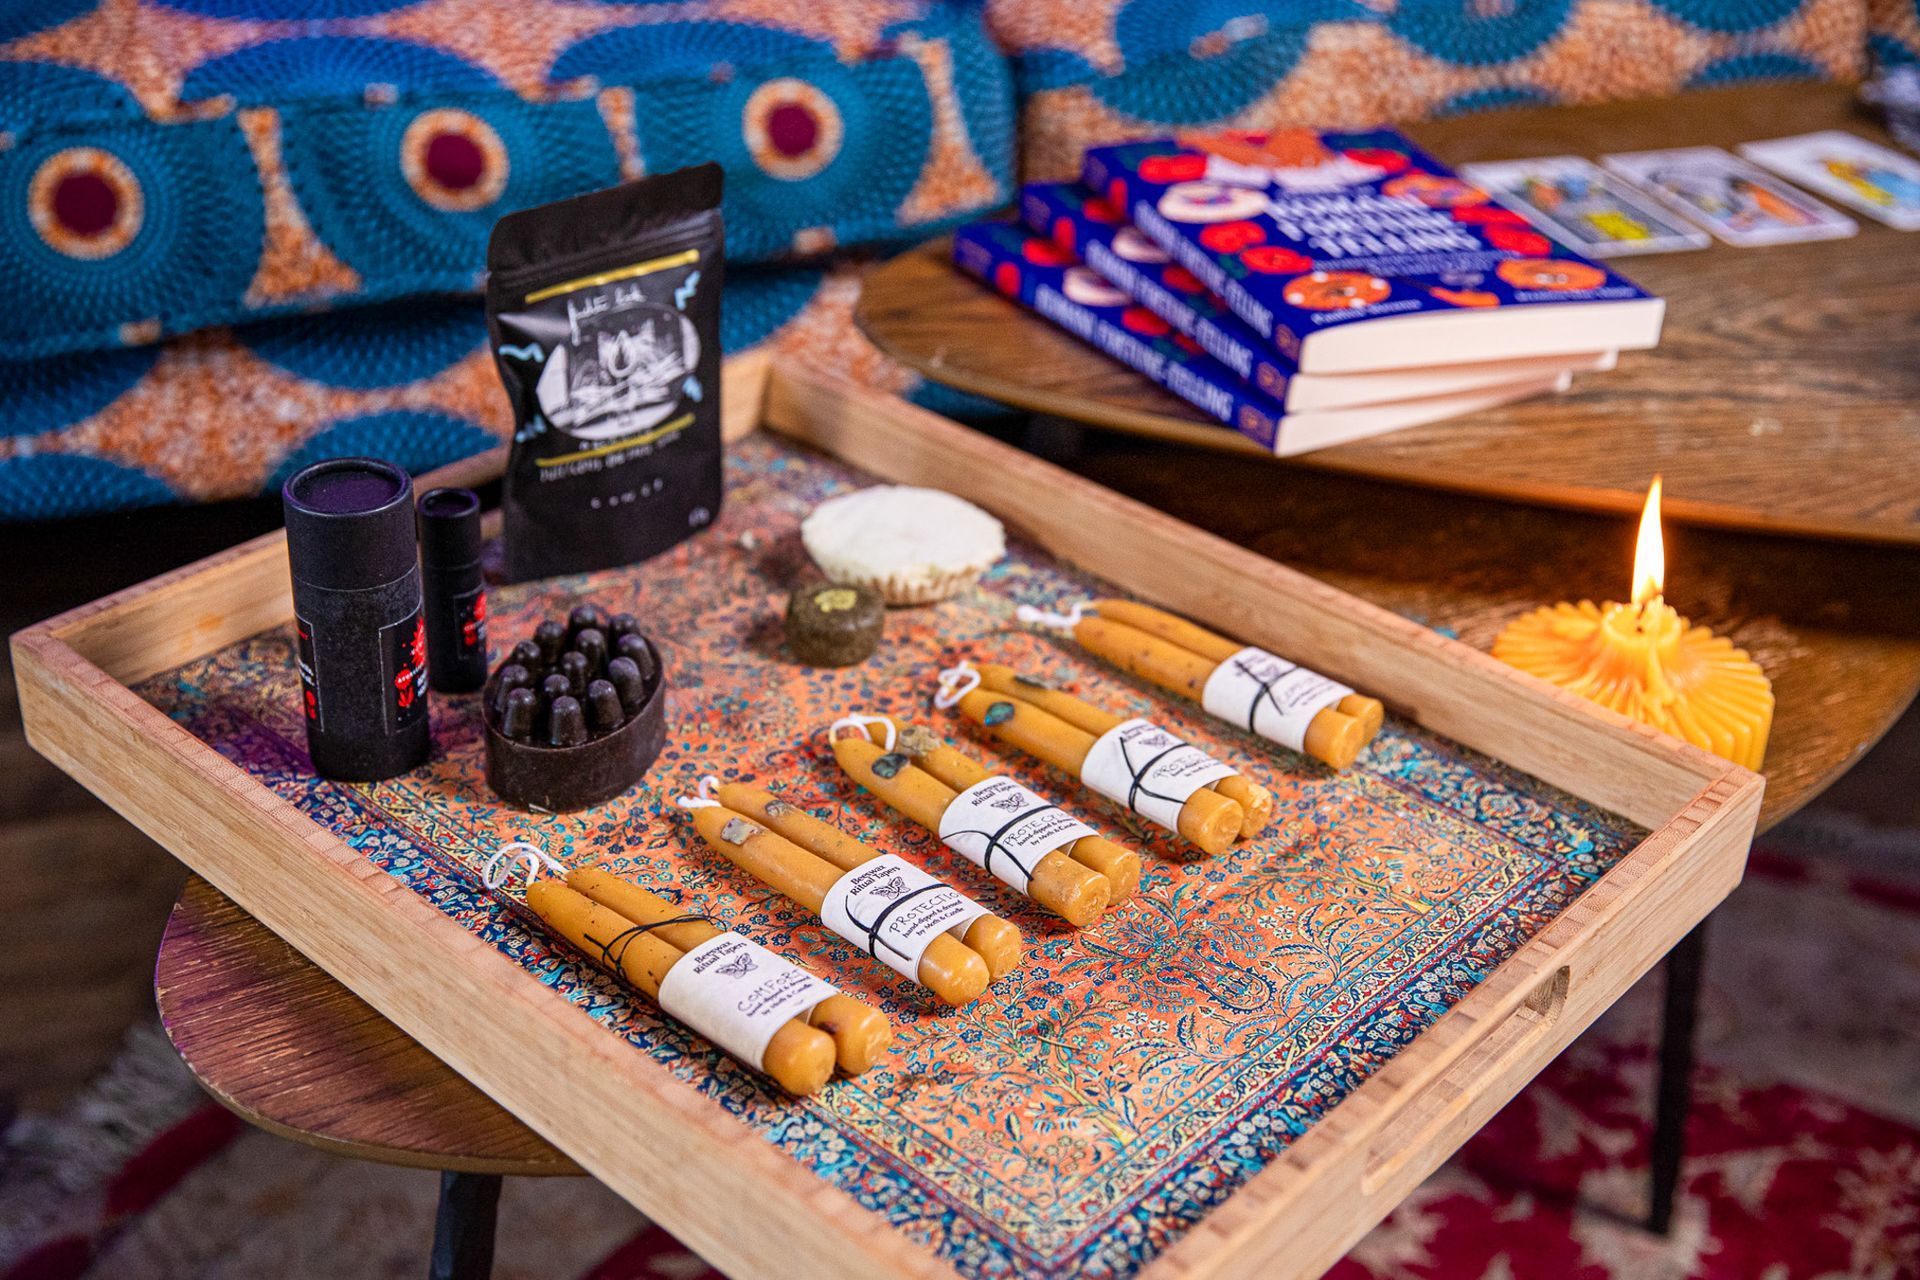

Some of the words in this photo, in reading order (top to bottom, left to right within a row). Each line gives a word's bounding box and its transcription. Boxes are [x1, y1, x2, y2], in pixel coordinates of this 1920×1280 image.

[971, 790, 996, 807] Ritual
[850, 865, 887, 885] Beeswax
[850, 876, 876, 896] Ritual
[872, 866, 901, 879] Tapers
[902, 910, 938, 939] hand-dipped
[916, 928, 926, 936] by
[694, 941, 733, 964] Beeswax
[693, 955, 720, 974] Ritual
